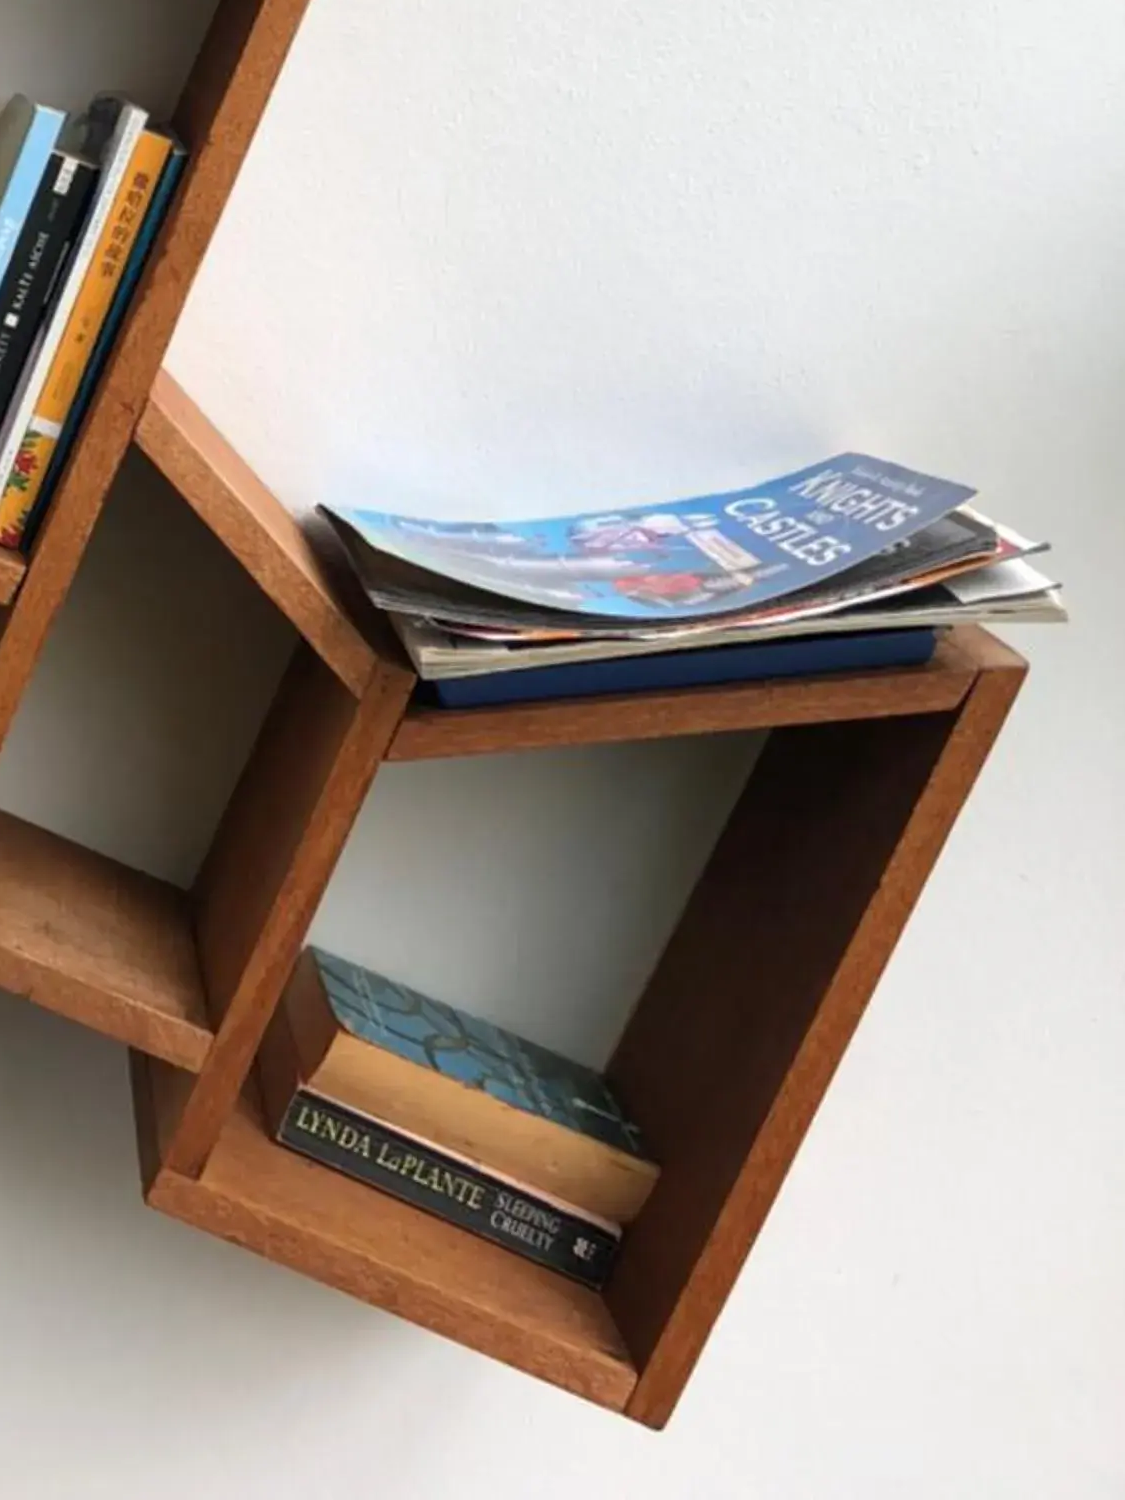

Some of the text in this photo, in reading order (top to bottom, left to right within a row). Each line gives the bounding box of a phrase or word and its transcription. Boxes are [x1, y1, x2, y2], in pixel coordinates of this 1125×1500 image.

[10, 273, 33, 310] KALTE
[788, 468, 919, 531] KNIGHTS
[724, 497, 852, 566] CASTLES
[297, 1109, 486, 1209] LYNDA LaPLANTE
[489, 1210, 553, 1250] CRUELTY
[497, 1191, 560, 1232] SLEEPING
